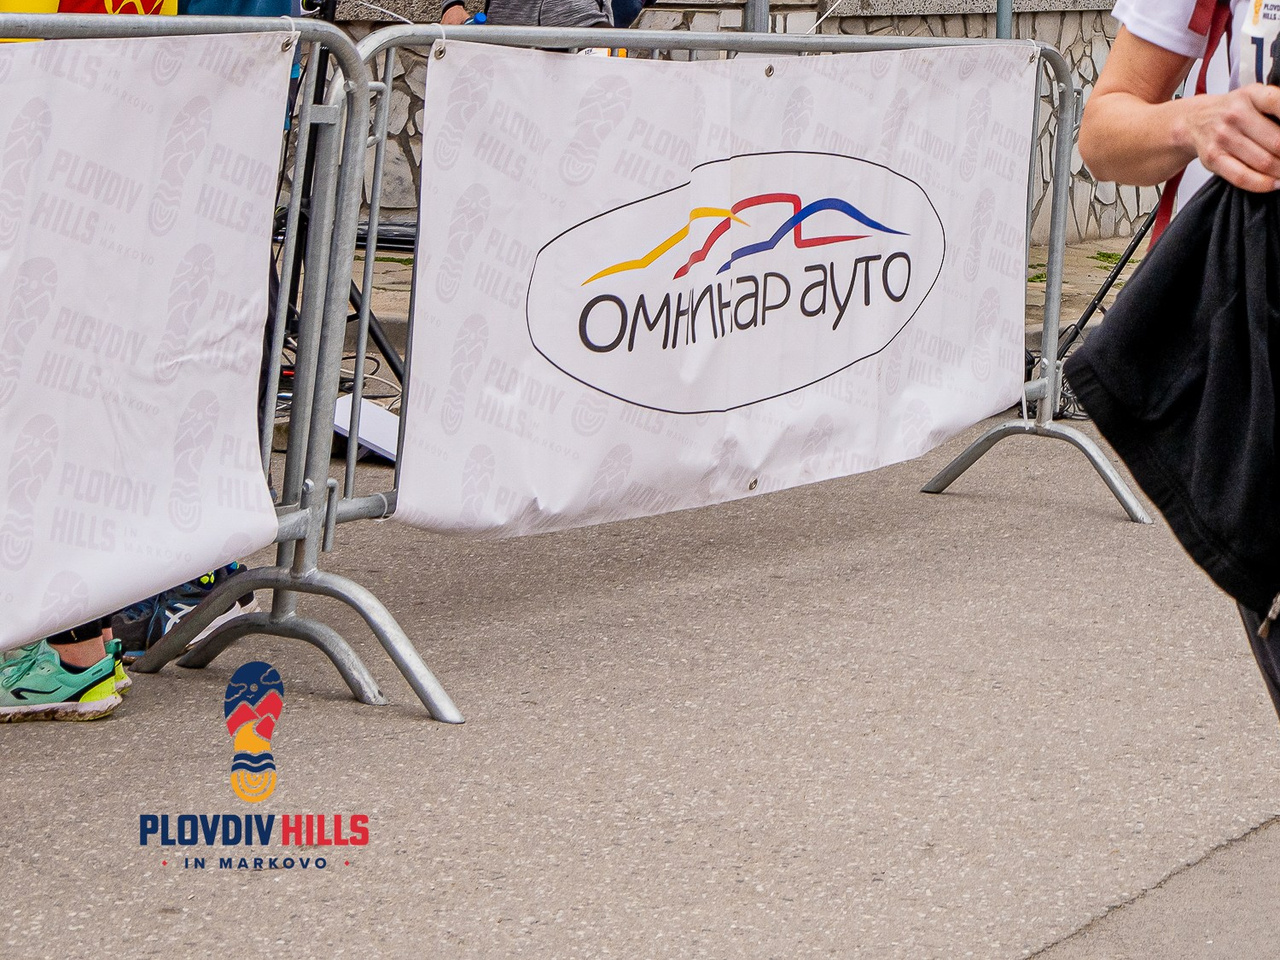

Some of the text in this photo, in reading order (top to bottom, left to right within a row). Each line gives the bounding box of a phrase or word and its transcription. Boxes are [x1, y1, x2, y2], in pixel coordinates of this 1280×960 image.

[473, 131, 528, 183] HILLS
[905, 121, 957, 166] PLOVDIV
[983, 147, 1016, 182] HILLS
[47, 147, 144, 215] PLOVDIV
[29, 191, 100, 246] HILLS
[195, 183, 255, 234] HILLS
[472, 262, 525, 310] HILLS
[987, 247, 1022, 281] HILLS
[51, 305, 149, 366] PLOVDIV
[914, 328, 966, 368] PLOVDIV
[35, 350, 102, 401] HILLS
[907, 357, 943, 389] HILLS
[473, 390, 528, 438] HILLS
[57, 461, 156, 517] PLOVDIV
[49, 506, 117, 553] HILLS
